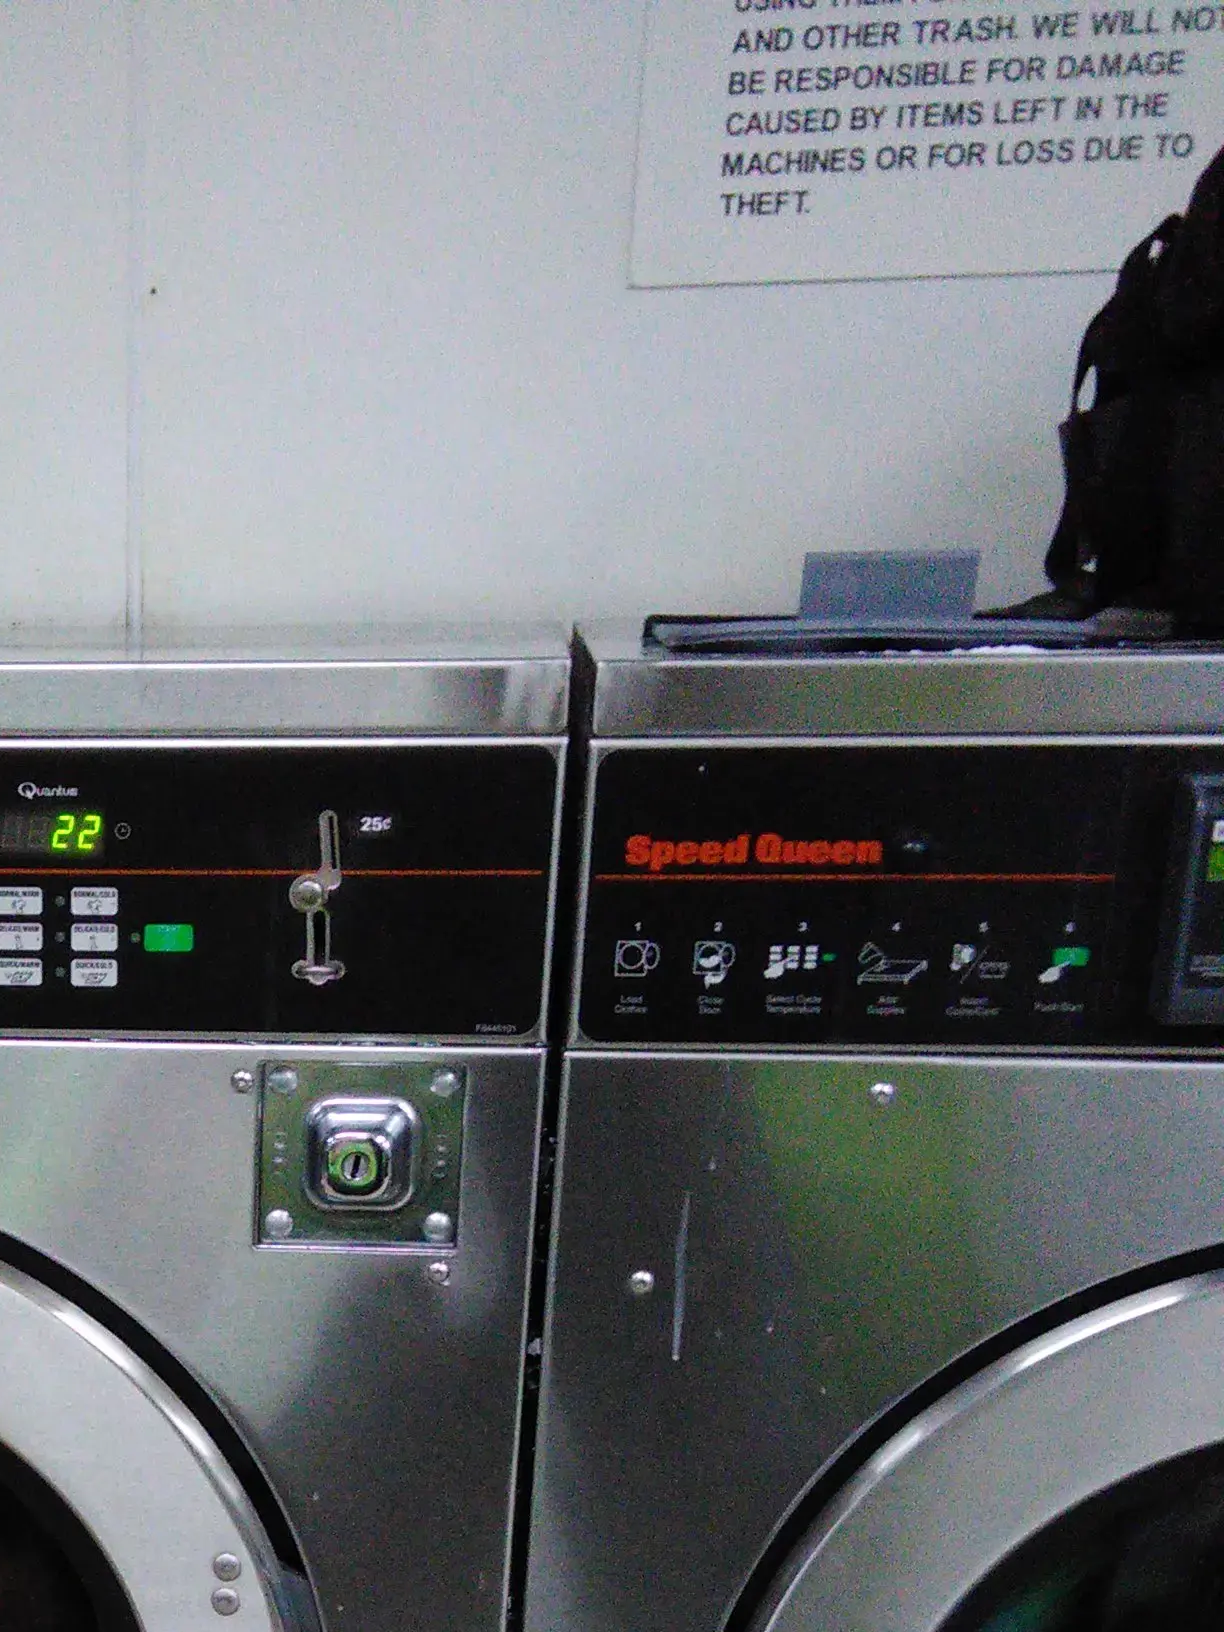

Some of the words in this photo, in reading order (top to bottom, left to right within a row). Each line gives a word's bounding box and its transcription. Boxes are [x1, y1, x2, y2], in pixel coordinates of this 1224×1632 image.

[733, 26, 794, 53] AND
[803, 22, 900, 50] OTHER
[1031, 12, 1078, 39] WE
[1091, 7, 1159, 36] WILL
[728, 69, 766, 95] BE
[775, 60, 977, 92] RESPONSIBLE
[986, 56, 1047, 84] FOR
[1056, 50, 1187, 80] DAMAGE
[726, 106, 841, 136] CAUSED
[850, 105, 887, 131] BY
[897, 100, 984, 129] ITEMS
[994, 96, 1067, 125] LEFT
[1075, 96, 1103, 120] IN
[1115, 92, 1169, 120] THE
[721, 146, 866, 177] MACHINES
[876, 145, 918, 170] OR
[929, 142, 987, 168] FOR
[997, 138, 1075, 166] LOSS
[1085, 134, 1144, 162] DUE
[1157, 132, 1194, 159] TO
[721, 189, 811, 217] THEFT.
[52, 814, 100, 849] 22
[359, 816, 392, 831] 25¢
[626, 833, 751, 872] Speed
[755, 832, 883, 864] Queen
